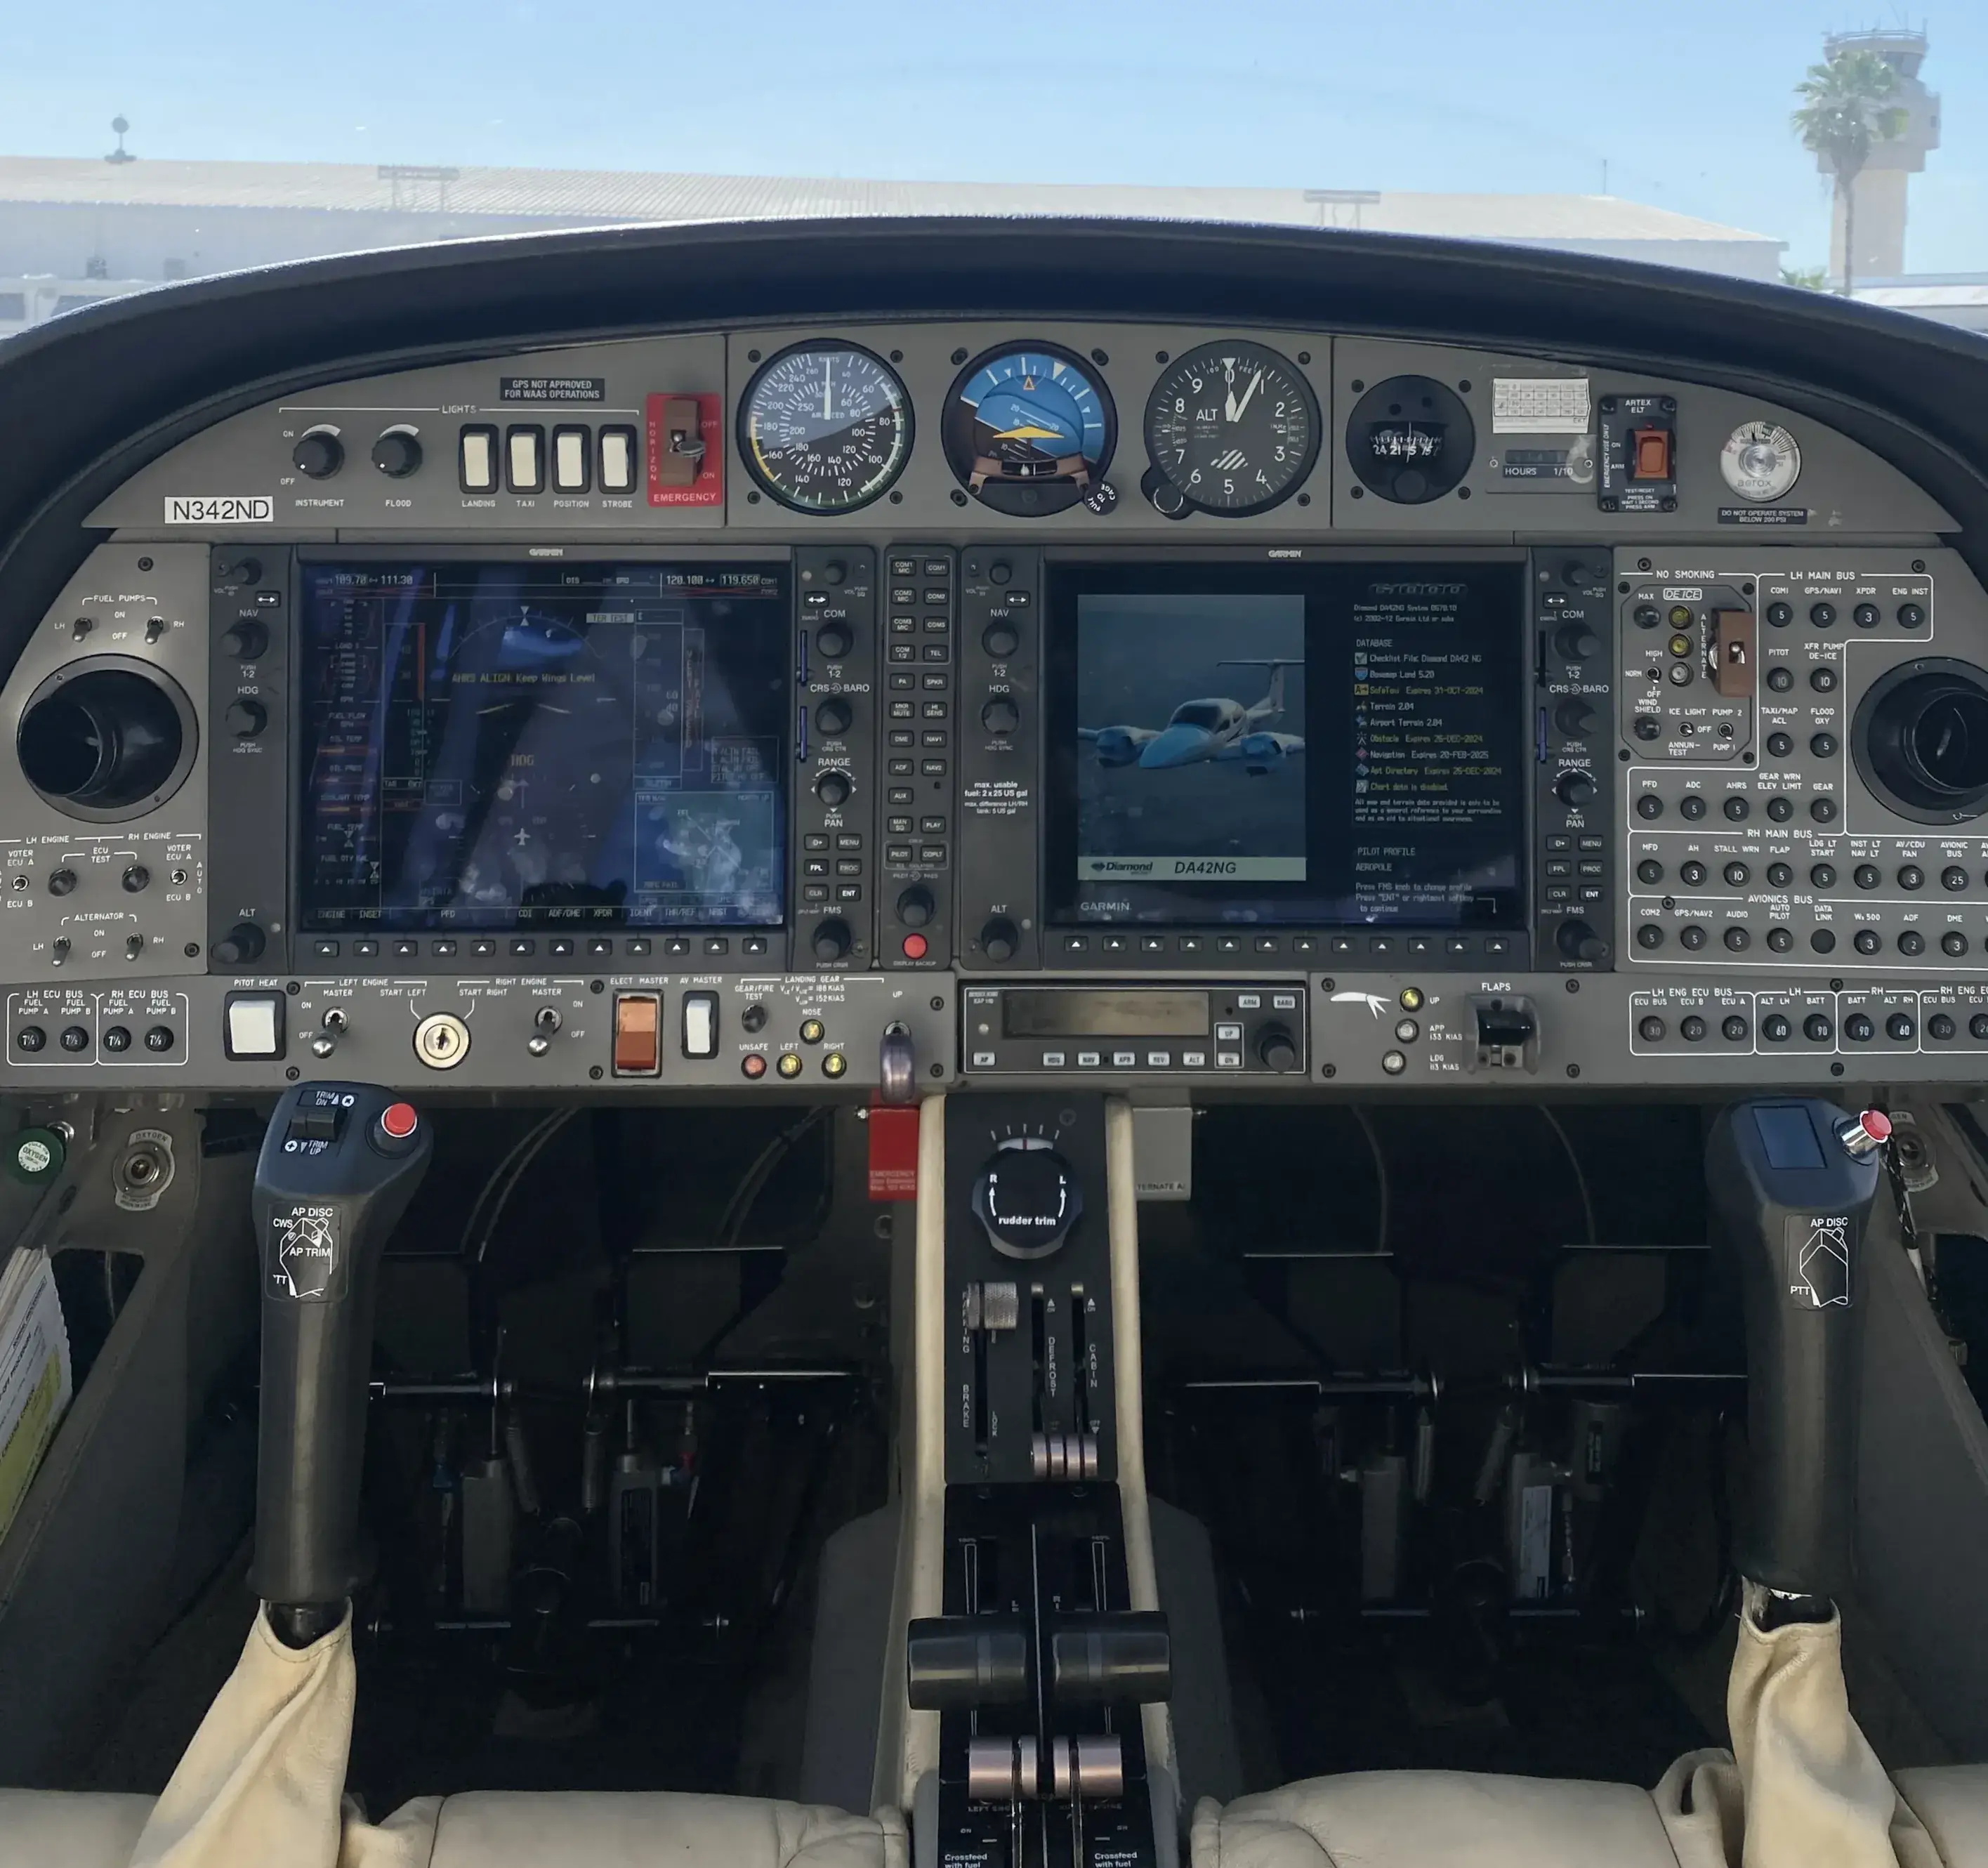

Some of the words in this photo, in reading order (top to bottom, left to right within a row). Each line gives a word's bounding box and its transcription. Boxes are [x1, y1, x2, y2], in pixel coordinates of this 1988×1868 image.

[549, 381, 592, 389] APPROVED
[1192, 378, 1203, 394] 9
[505, 390, 521, 398] FOR
[523, 390, 547, 398] WAAS
[549, 390, 600, 398] OPERATIONS
[442, 405, 477, 414] LIGHTS
[1175, 397, 1185, 413] 8
[1275, 402, 1285, 417] 2
[1196, 409, 1218, 421] ALT
[1505, 468, 1536, 476] HOURS
[1553, 467, 1573, 476] 1/10
[1223, 479, 1234, 494] 5
[653, 493, 716, 501] EMERGENCY
[386, 499, 412, 508] FLOOD
[173, 500, 269, 521] N342ND
[1656, 570, 1668, 579] NO
[1675, 570, 1715, 579] SMOKING
[1790, 572, 1803, 580] LH
[1808, 572, 1831, 580] MAIN
[1836, 572, 1855, 580] BUS
[119, 594, 146, 603] PUMPS
[239, 609, 258, 618] NAV
[824, 610, 846, 618] COM
[1356, 639, 1393, 647] DATABASE
[237, 686, 258, 695] HDG
[810, 684, 829, 692] CRS
[843, 684, 869, 692] BARO
[1583, 685, 1609, 693] BARO
[817, 758, 851, 766] RANGE
[1642, 780, 1658, 789] PFD
[1016, 789, 1028, 798] gal
[824, 819, 843, 828] PAN
[1747, 829, 1760, 838] RH
[1793, 830, 1812, 838] BUS
[1383, 848, 1416, 856] PROFILE
[1714, 845, 1737, 853] STALL
[1106, 862, 1153, 871] Diamond
[1174, 862, 1237, 874] DA42NG
[1951, 876, 1964, 885] 25
[1748, 895, 1789, 904] AVIONICS
[1793, 895, 1813, 904] BUS
[1080, 902, 1130, 912] GARMIN
[74, 913, 124, 921] ALTERNATOR
[239, 908, 256, 917] ALT
[1674, 909, 1713, 918] GPS/NAV2
[339, 978, 358, 987] LEFT
[362, 978, 388, 987] ENGINE
[1482, 982, 1511, 992] FLAPS
[1652, 988, 1665, 997] LH
[1669, 988, 1687, 997] ENG
[1692, 988, 1710, 997] ECU
[1714, 987, 1733, 997] BUS
[291, 1208, 305, 1216] AP
[308, 1208, 334, 1217] DISC
[273, 1218, 293, 1228] CWS
[998, 1216, 1032, 1225] rudder
[1034, 1216, 1056, 1226] trim
[1810, 1218, 1824, 1227] AP
[1826, 1217, 1849, 1227] DISC
[289, 1248, 303, 1256] AP
[305, 1248, 330, 1257] TRIM
[1790, 1286, 1810, 1295] PTT
[1095, 1852, 1138, 1860] Crossfeed
